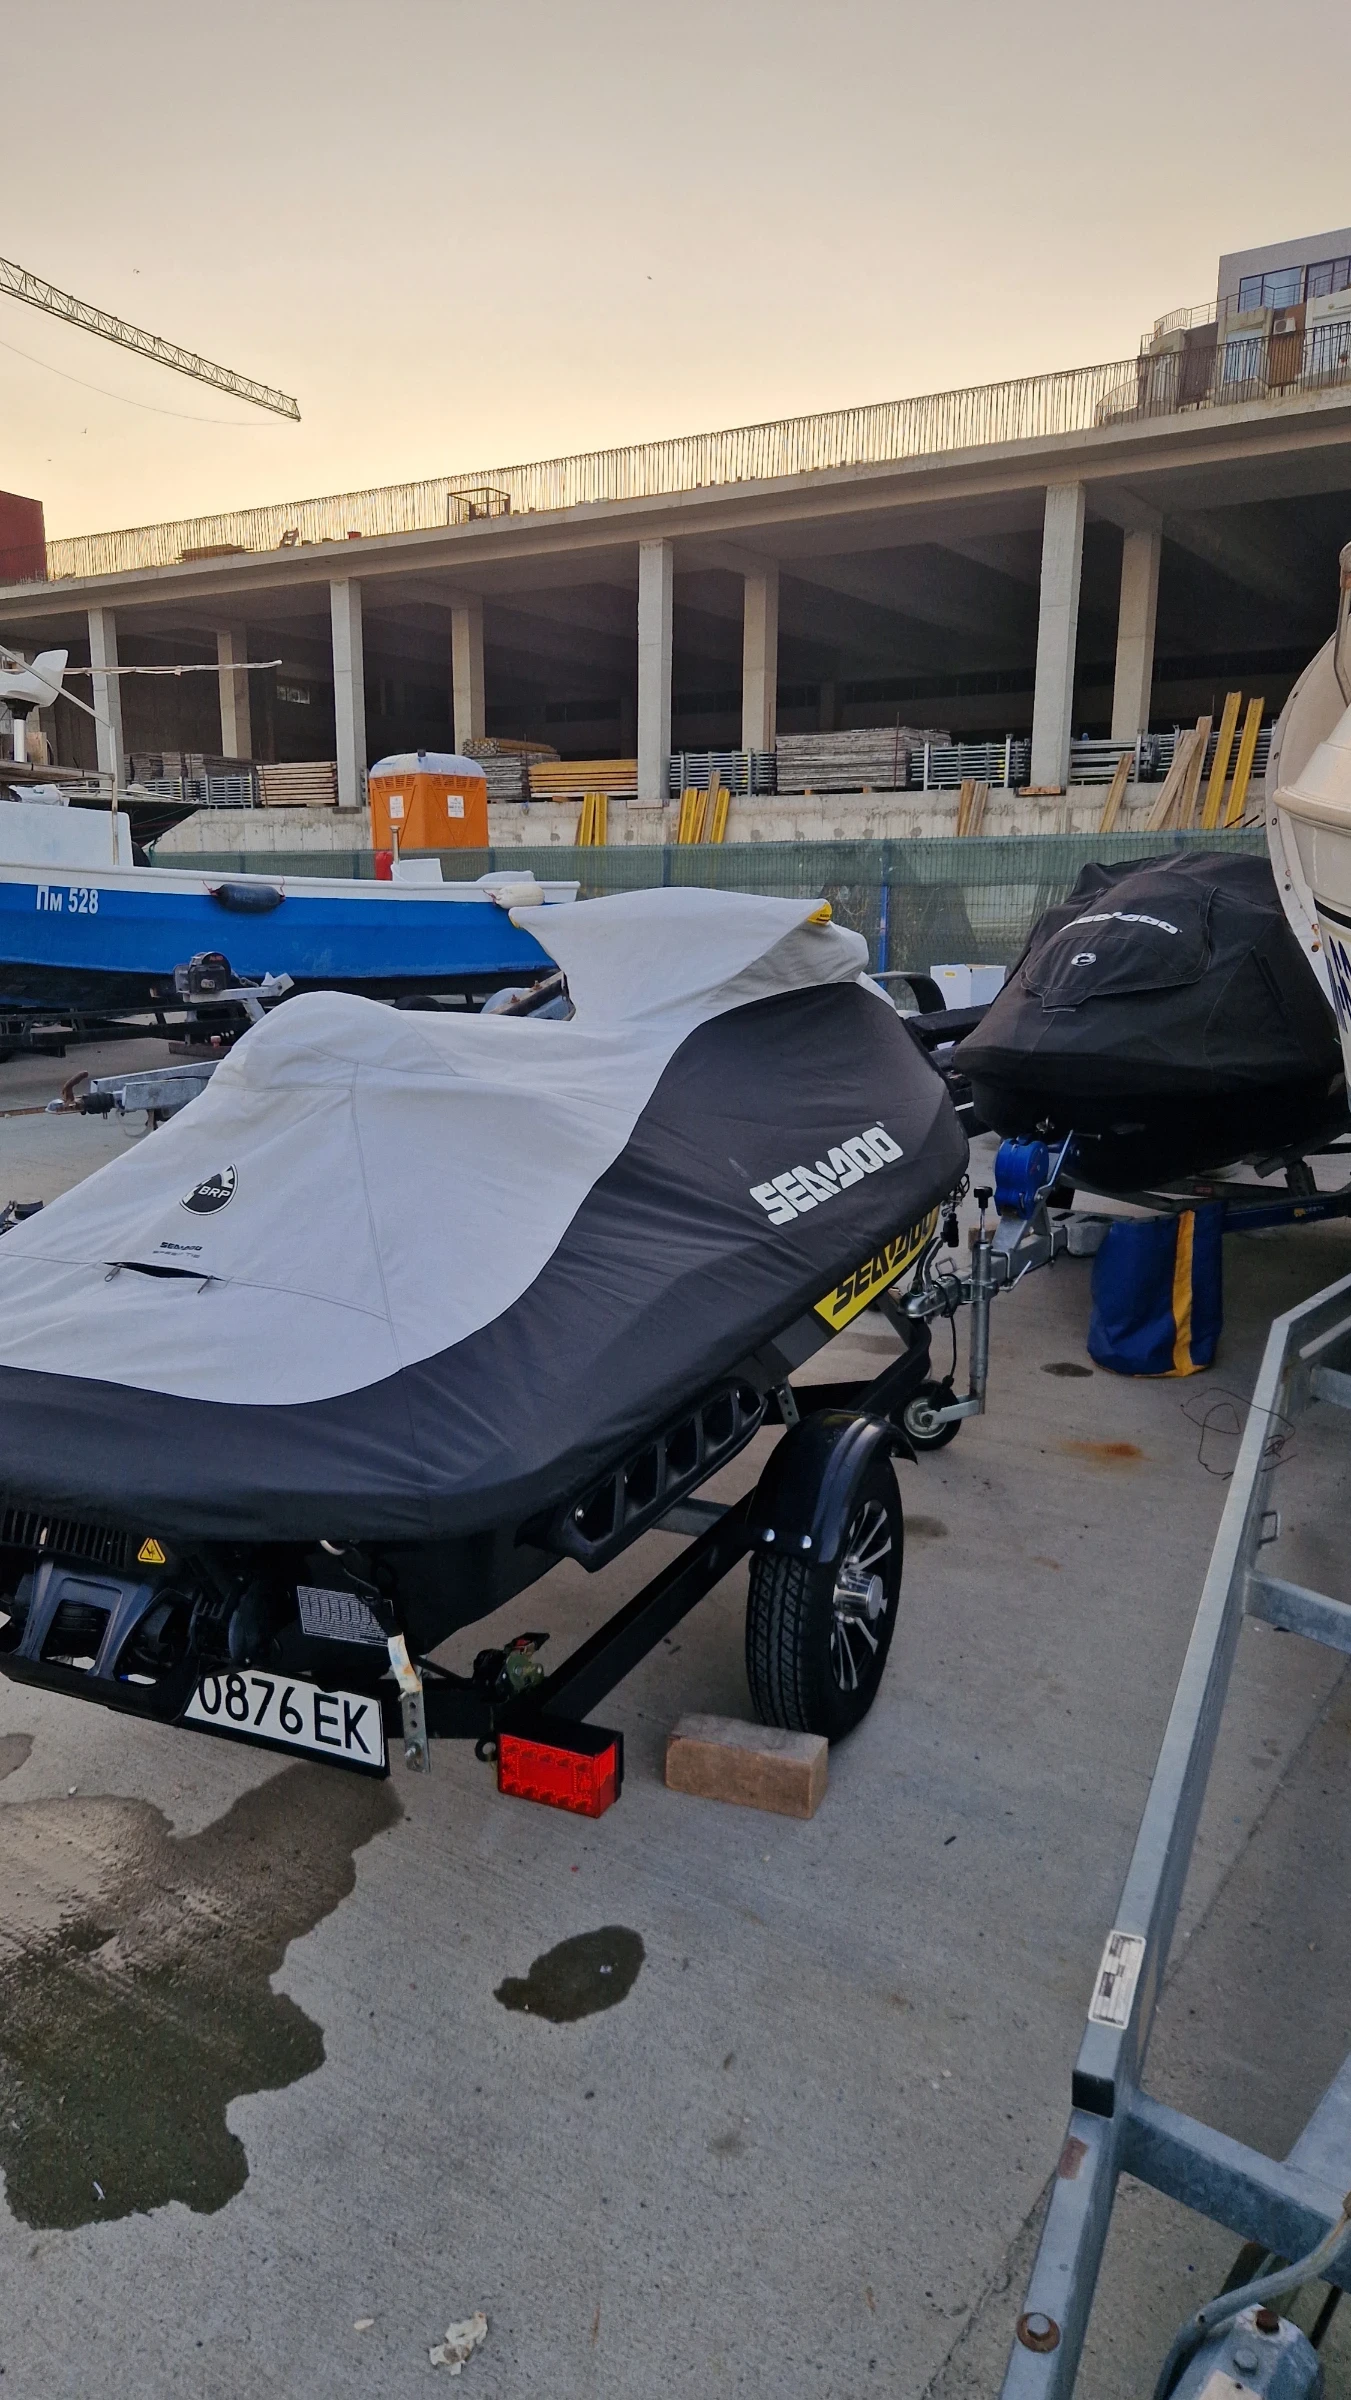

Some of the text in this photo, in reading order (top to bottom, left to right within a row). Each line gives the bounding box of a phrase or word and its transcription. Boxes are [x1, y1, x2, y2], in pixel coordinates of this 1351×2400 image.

[36, 886, 99, 914] Пм 528
[198, 1185, 231, 1199] BRP
[200, 1674, 372, 1755] 0876 EK
